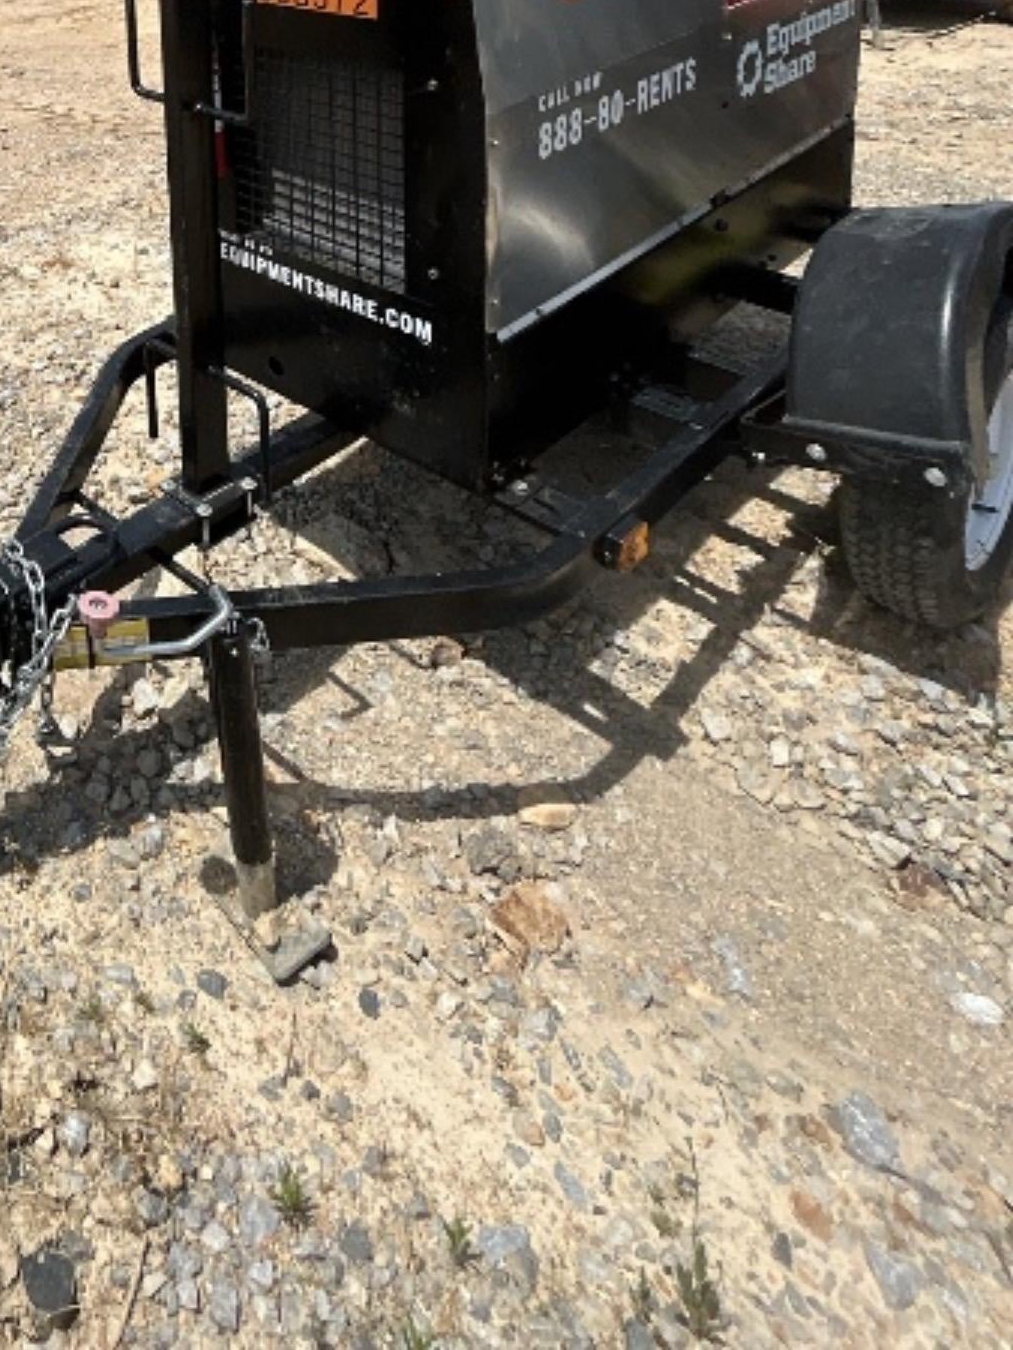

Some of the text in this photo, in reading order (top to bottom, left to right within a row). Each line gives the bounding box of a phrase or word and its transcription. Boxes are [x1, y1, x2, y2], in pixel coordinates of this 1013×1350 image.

[539, 56, 697, 160] 888-80-RENTS
[763, 50, 817, 94] Share
[220, 241, 433, 346] EQUIPMENTSHARE.COM
